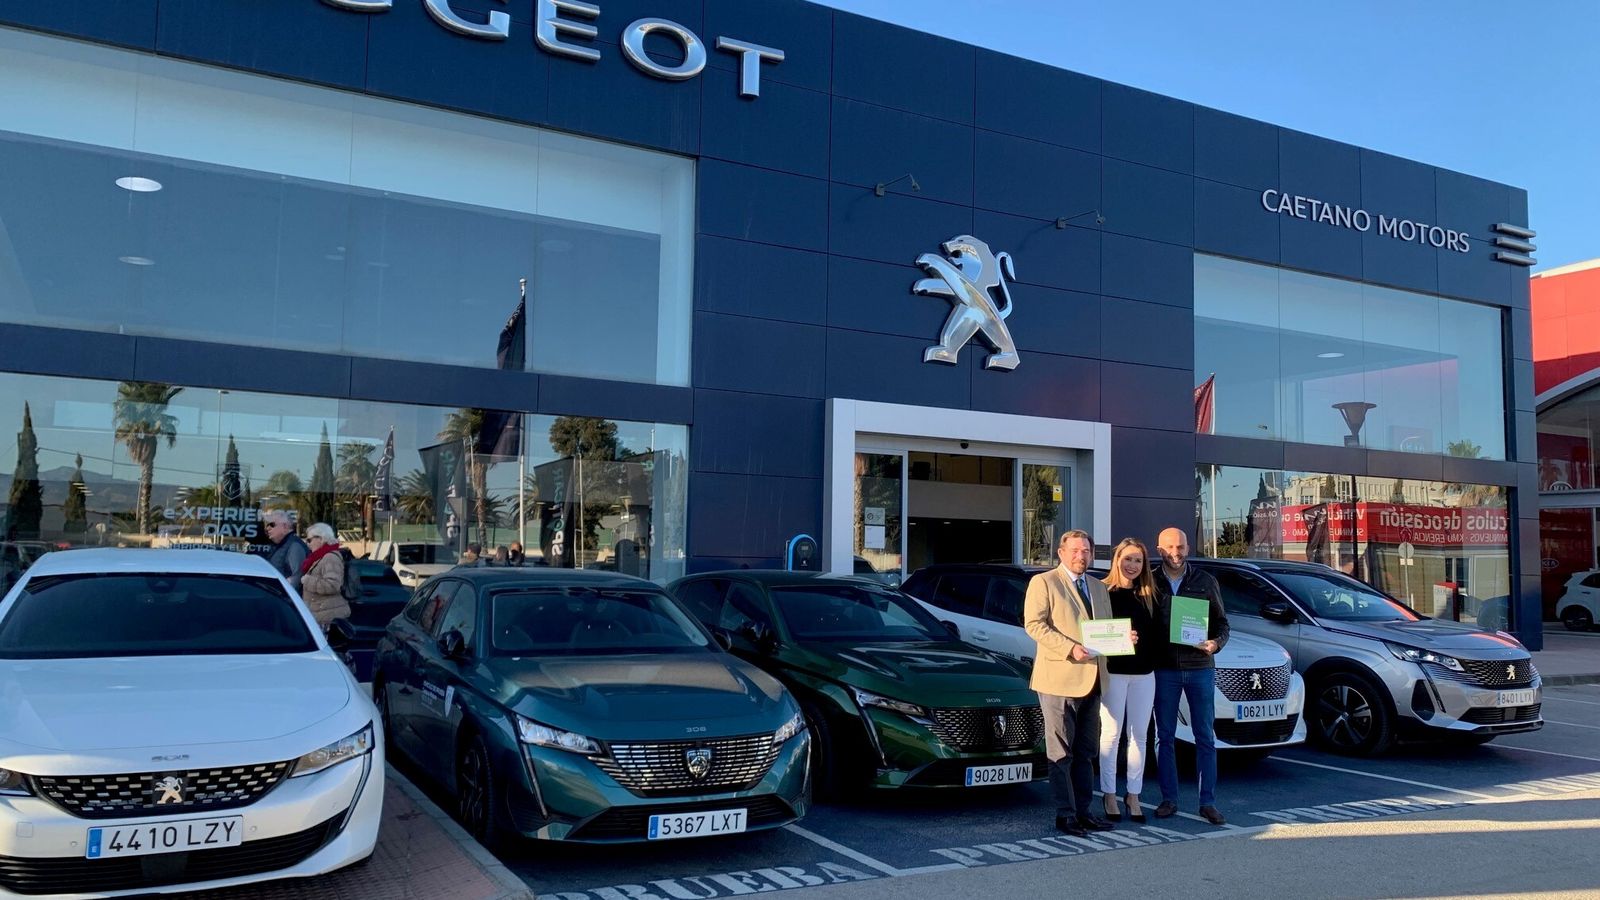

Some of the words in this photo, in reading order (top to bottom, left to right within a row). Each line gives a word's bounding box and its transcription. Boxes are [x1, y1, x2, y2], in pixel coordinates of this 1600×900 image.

[318, 0, 785, 98] GEOT
[1261, 188, 1371, 232] CAETANO
[1378, 214, 1470, 254] MOTORS
[204, 524, 257, 538] DAYS
[1243, 704, 1267, 718] 0621
[1269, 703, 1285, 717] LYY
[974, 768, 1004, 783] 9028
[1007, 766, 1029, 781] LVN
[662, 816, 705, 835] 5367
[710, 813, 743, 832] LXT
[1249, 796, 1458, 824] PRUEBA
[108, 828, 178, 852] 4410
[187, 820, 236, 846] LZY
[930, 825, 1197, 868] PRUEBA
